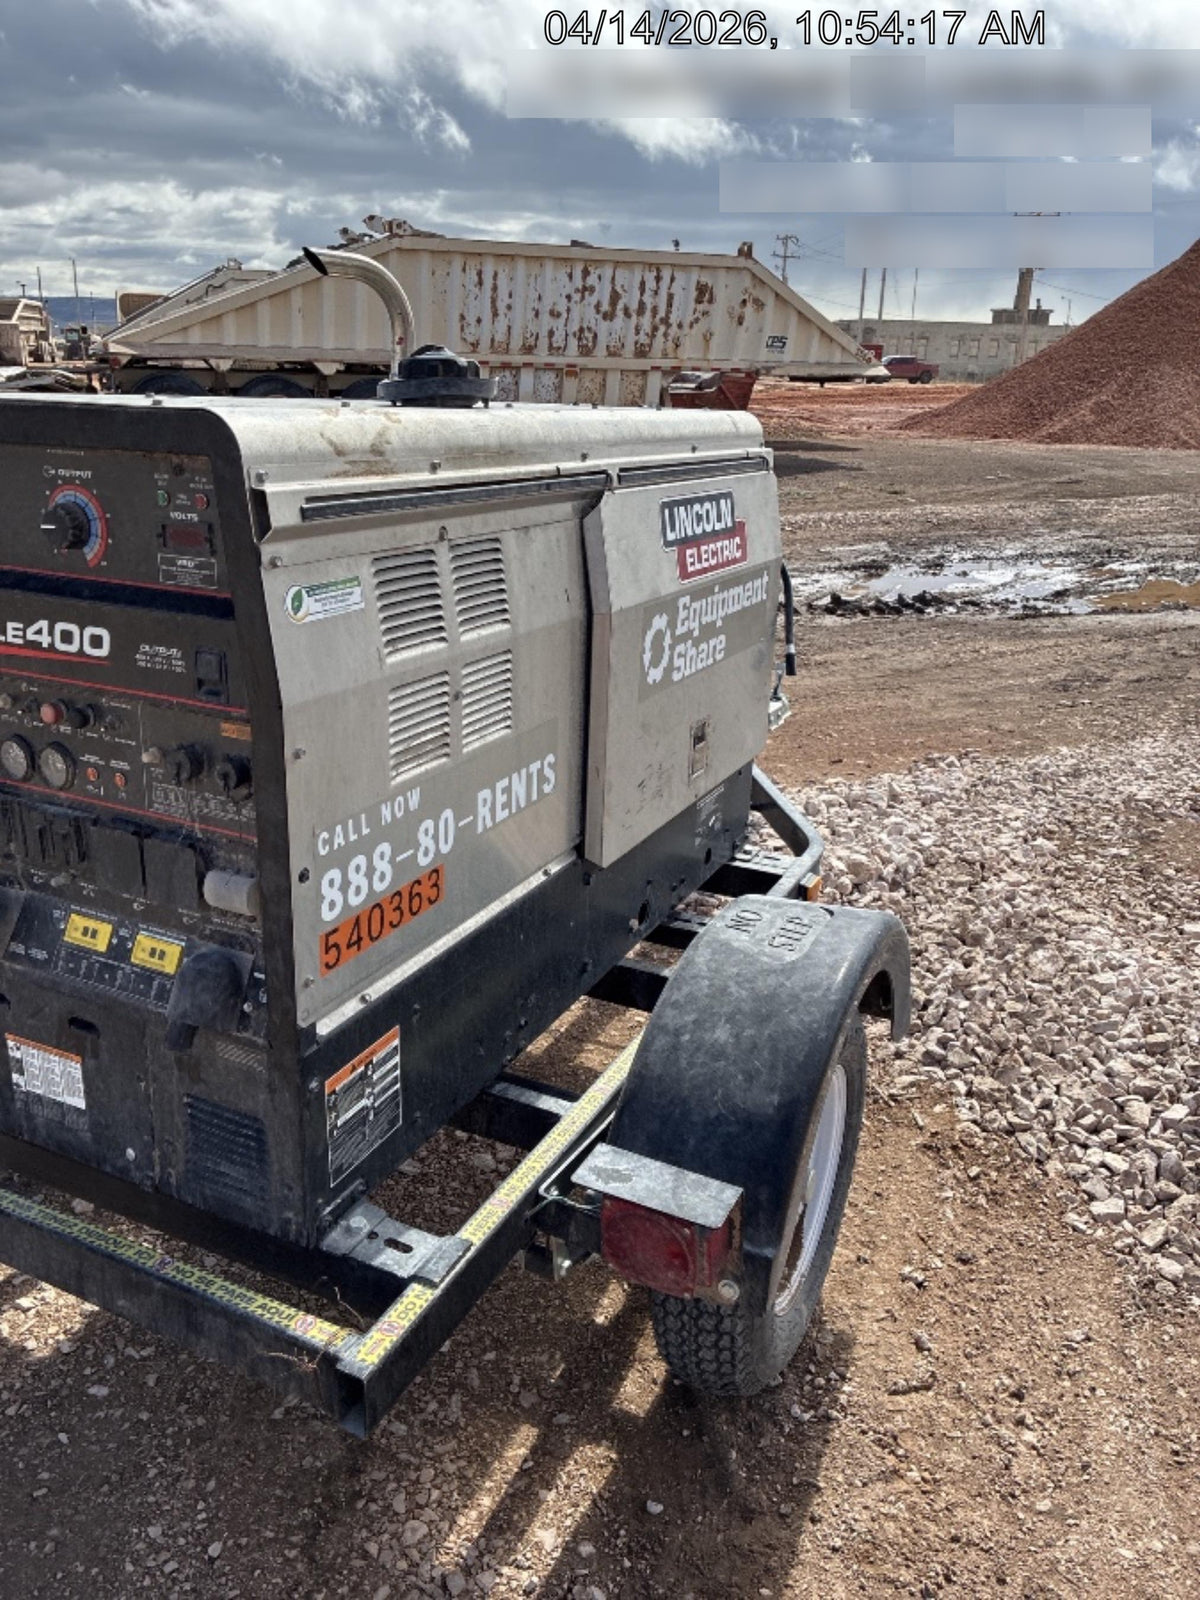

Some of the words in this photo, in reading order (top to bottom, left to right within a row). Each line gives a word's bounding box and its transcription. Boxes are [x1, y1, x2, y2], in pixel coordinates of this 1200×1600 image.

[57, 468, 92, 479] OUTPUT
[169, 511, 199, 522] VOLTS
[664, 498, 733, 541] LINCOLN
[685, 536, 742, 572] ELECTRIC
[675, 571, 769, 637] Equipment
[0, 619, 111, 657] E400
[672, 634, 726, 682] Share
[317, 822, 371, 857] CALL
[381, 786, 422, 826] NOW
[320, 752, 556, 922] 888-80-RENTS
[323, 867, 442, 970] 540363
[725, 909, 763, 934] NO
[767, 915, 814, 952] STEP
[171, 1263, 195, 1279] NO
[194, 1274, 216, 1288] SE
[216, 1283, 257, 1304] PARE
